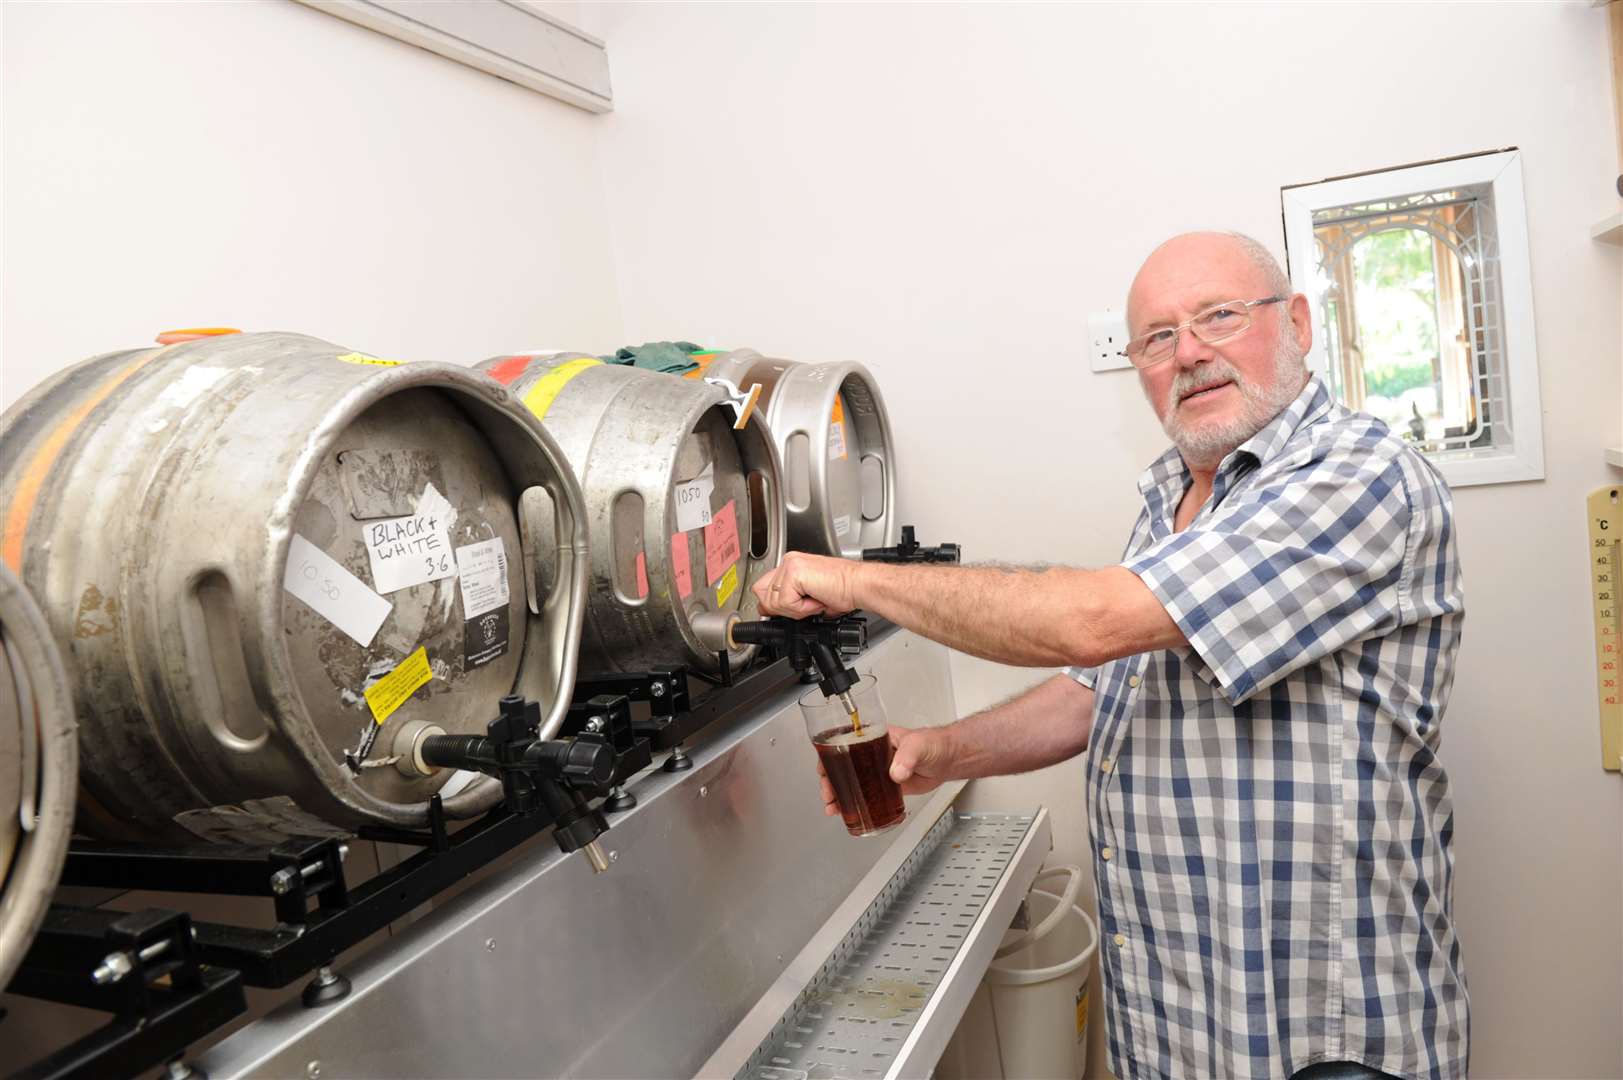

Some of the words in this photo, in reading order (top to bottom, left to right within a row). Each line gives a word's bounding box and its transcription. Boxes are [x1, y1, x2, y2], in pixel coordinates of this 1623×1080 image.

[677, 487, 700, 506] 1050
[372, 517, 424, 547] BLACK
[1595, 538, 1606, 547] 50
[378, 534, 441, 560] WHITE
[1597, 556, 1607, 564] 40
[1597, 574, 1608, 582] 30
[1598, 592, 1609, 600] 20
[1603, 644, 1613, 652] 10
[1602, 662, 1613, 670] 20
[1603, 679, 1614, 687] 30
[1604, 696, 1615, 704] 40
